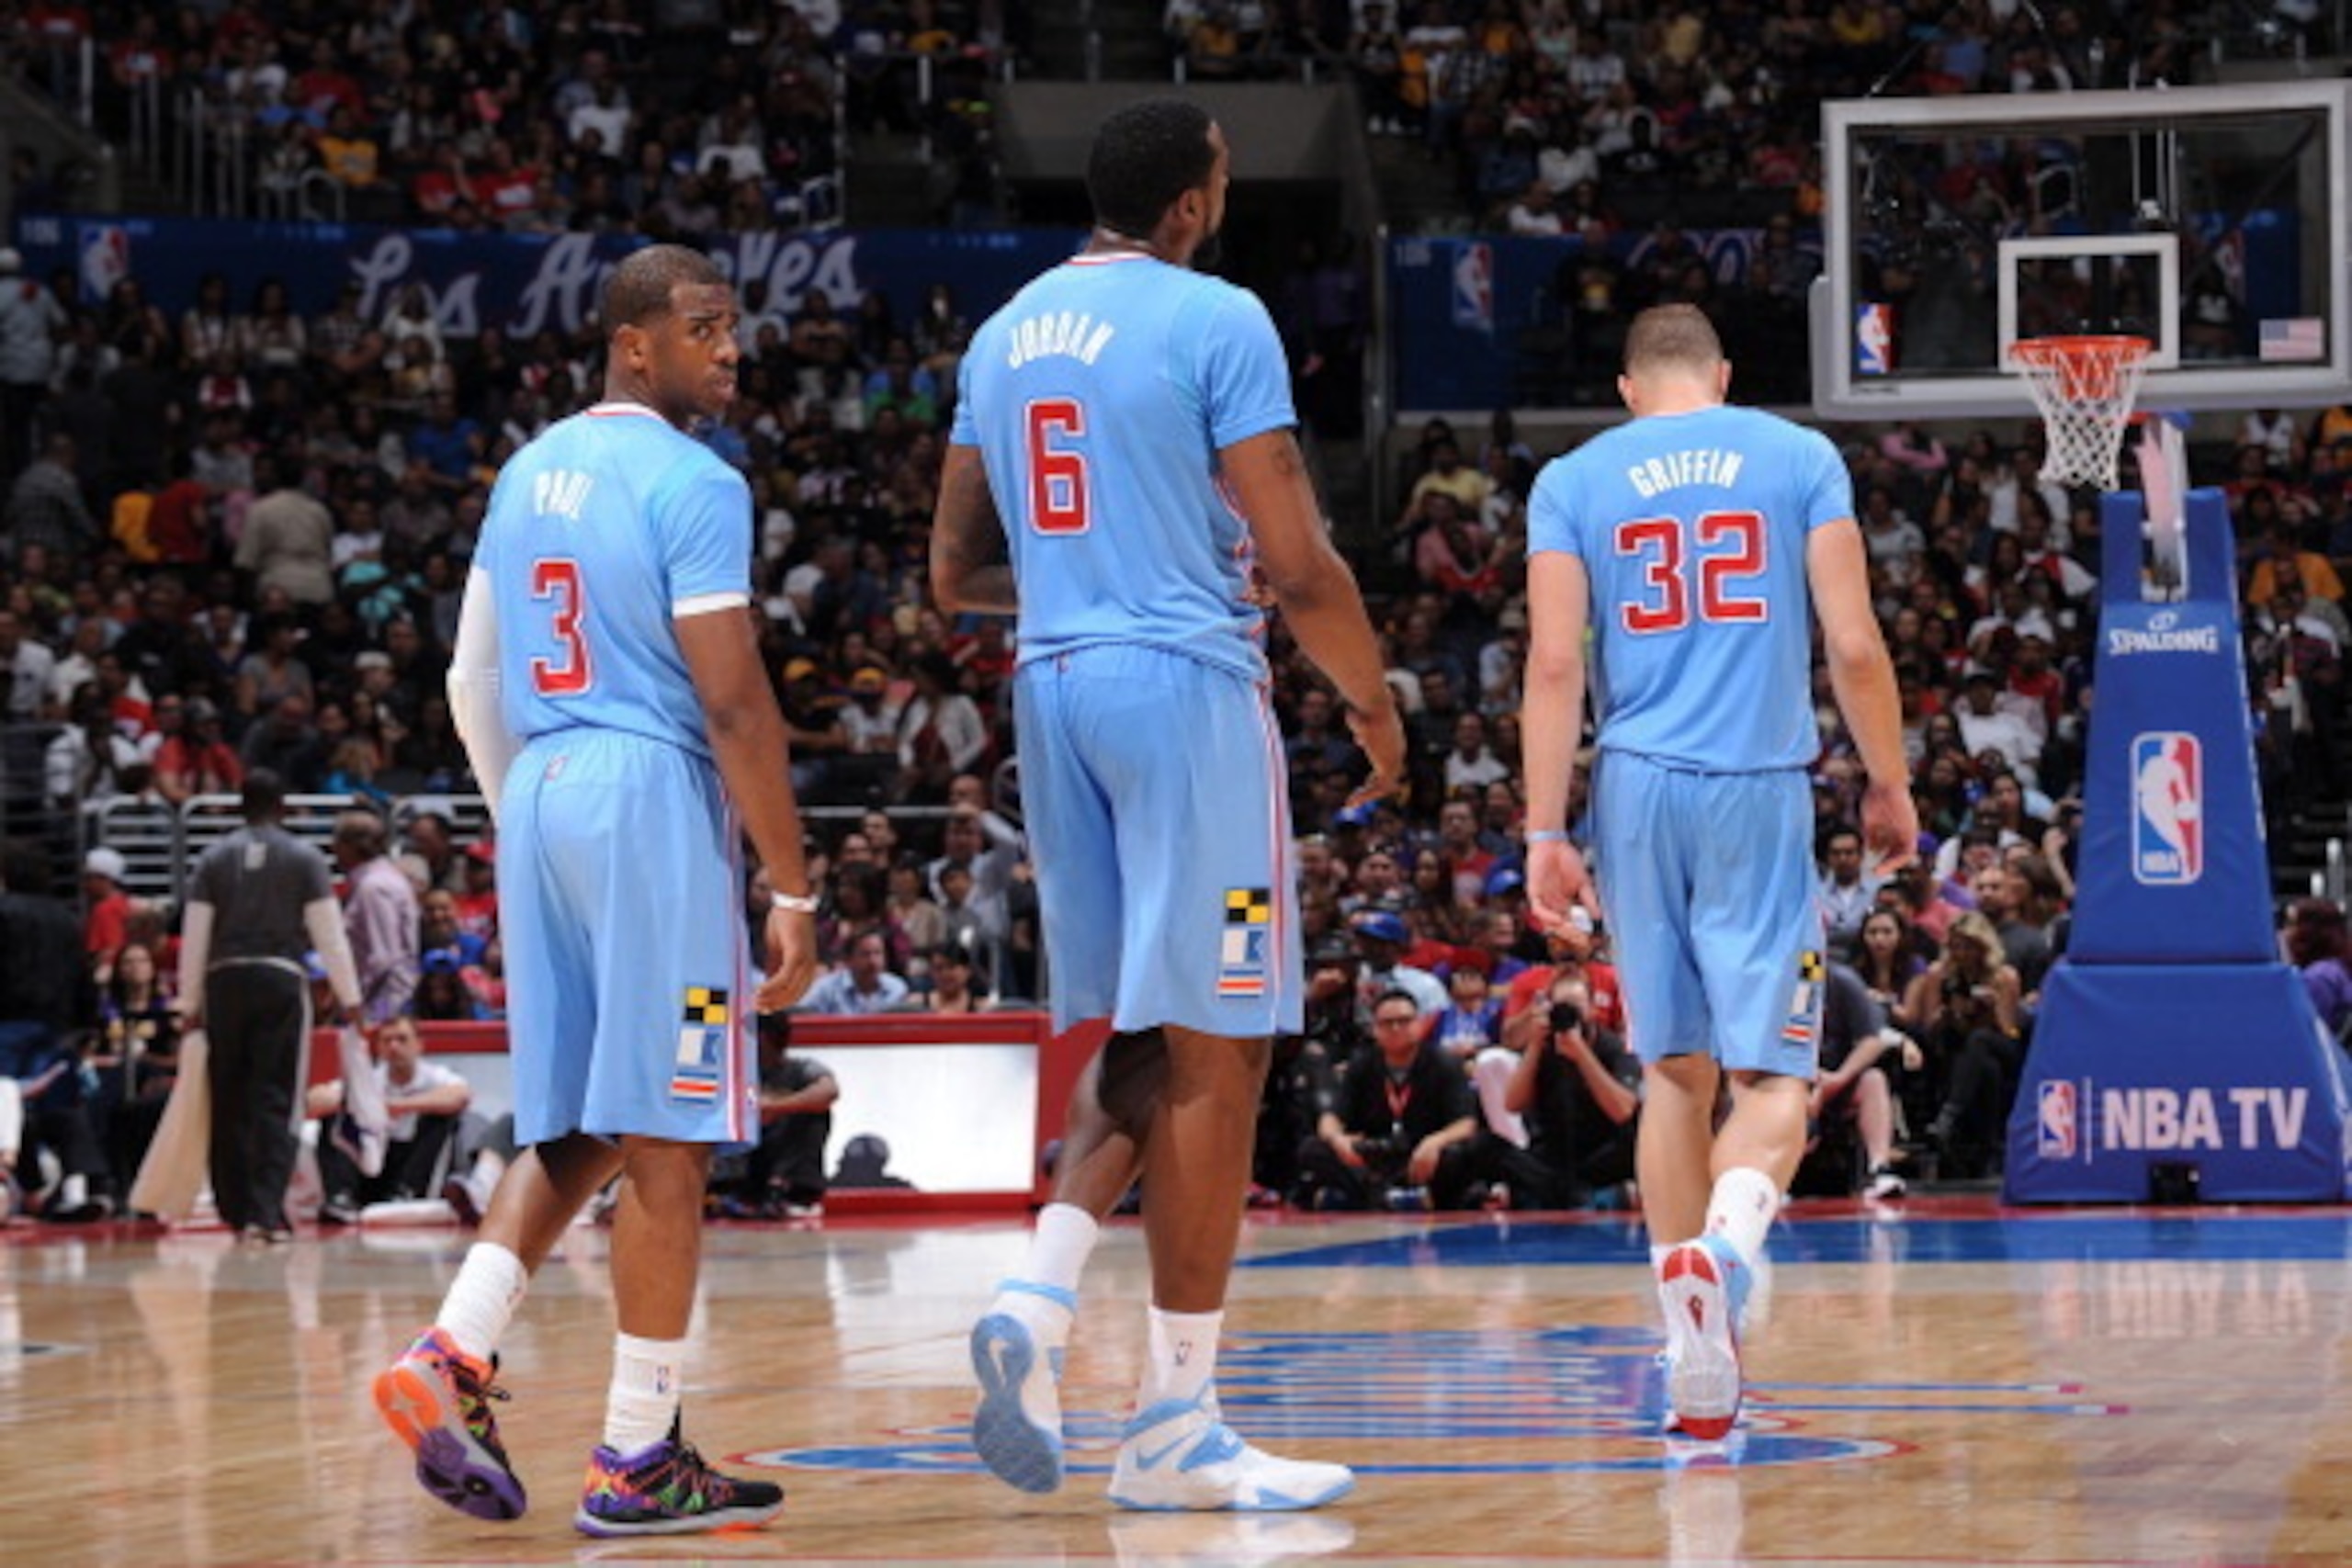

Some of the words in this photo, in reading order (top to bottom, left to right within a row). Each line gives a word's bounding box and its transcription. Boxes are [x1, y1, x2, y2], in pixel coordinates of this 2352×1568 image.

[1008, 310, 1114, 369] JORDAN
[1024, 397, 1091, 536] 6
[1627, 447, 1743, 498] GRIFFIN
[1614, 510, 1768, 635] 32
[529, 558, 593, 697] 3
[2109, 626, 2219, 656] SPALDING
[2102, 1088, 2223, 1148] NBA
[2229, 1088, 2309, 1148] TV
